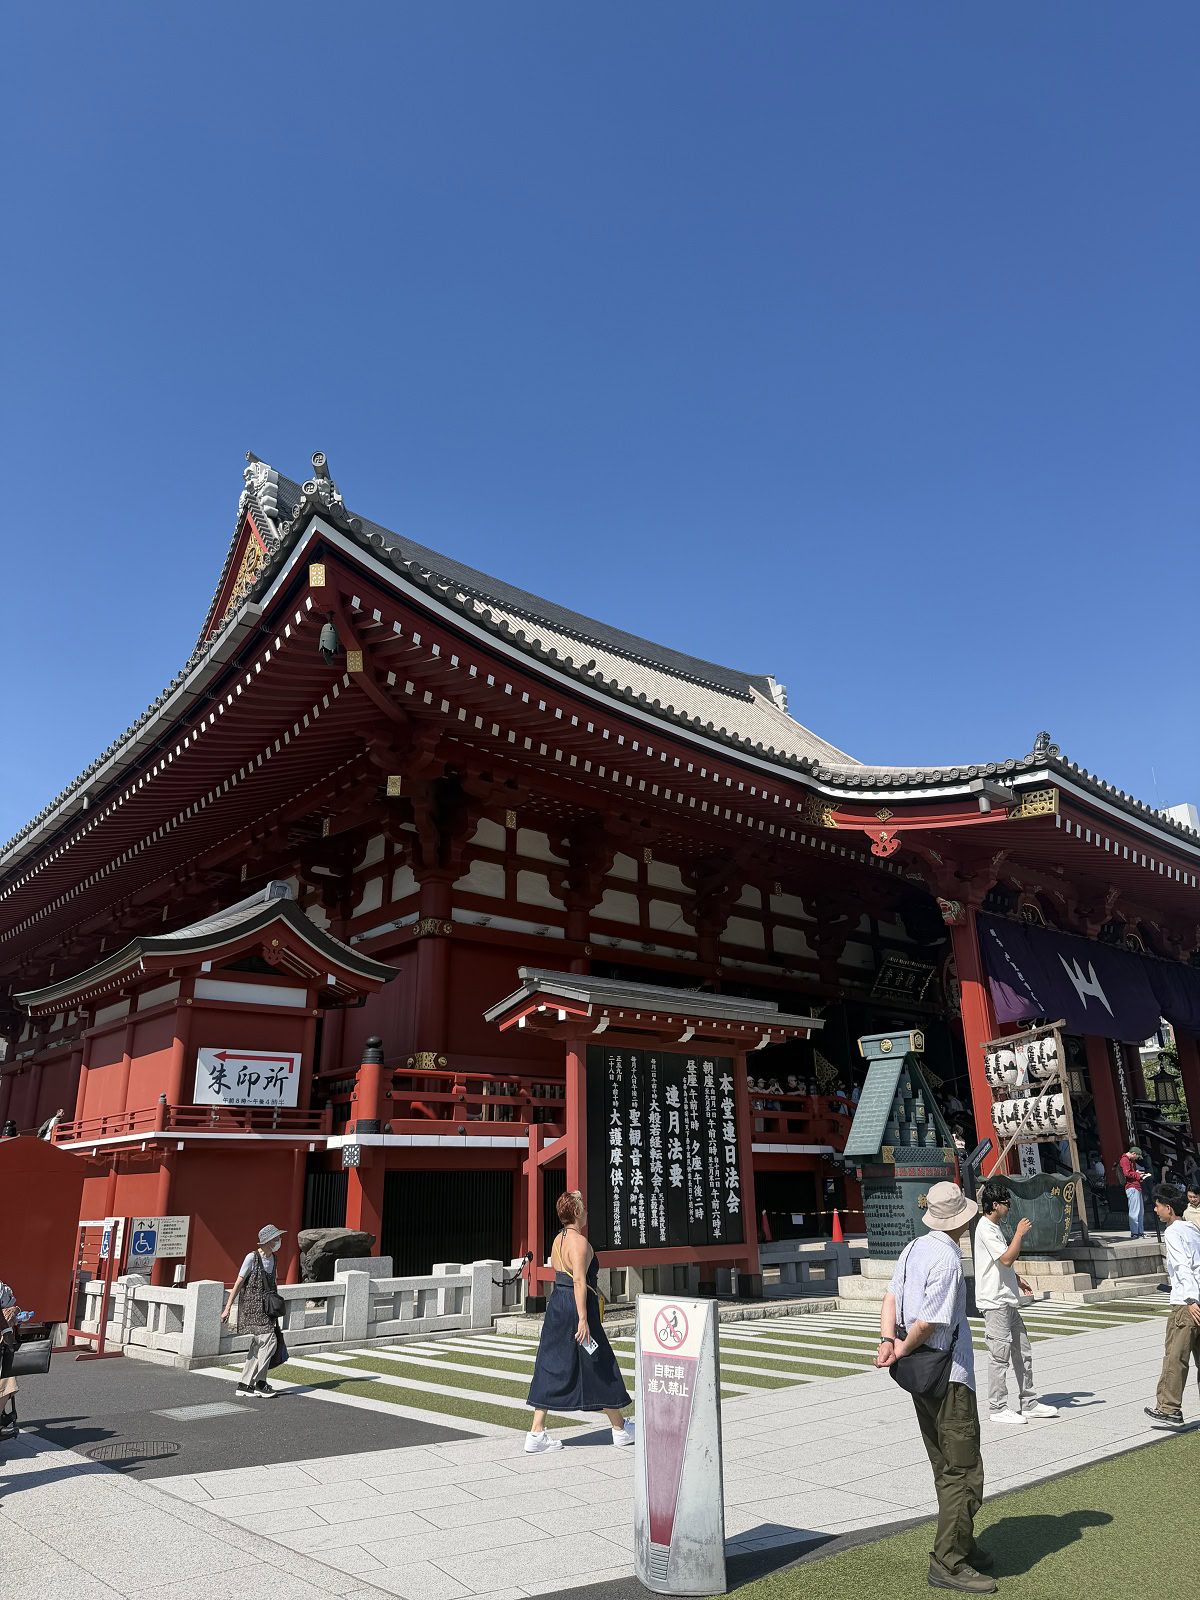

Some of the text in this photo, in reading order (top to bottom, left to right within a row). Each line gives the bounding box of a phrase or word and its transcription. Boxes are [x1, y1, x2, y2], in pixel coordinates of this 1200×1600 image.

[208, 1063, 289, 1098] 朱印所
[703, 1061, 715, 1087] 朝座
[609, 1108, 624, 1186] 大護摩供
[665, 1084, 684, 1188] 連月法要
[707, 1119, 717, 1155] 午前六時
[719, 1072, 740, 1213] 本堂連日法会
[691, 1139, 703, 1171] 夕座
[711, 1188, 721, 1239] 午前六時半
[648, 1379, 689, 1397] 進入禁止
[654, 1363, 685, 1379] 自転車
